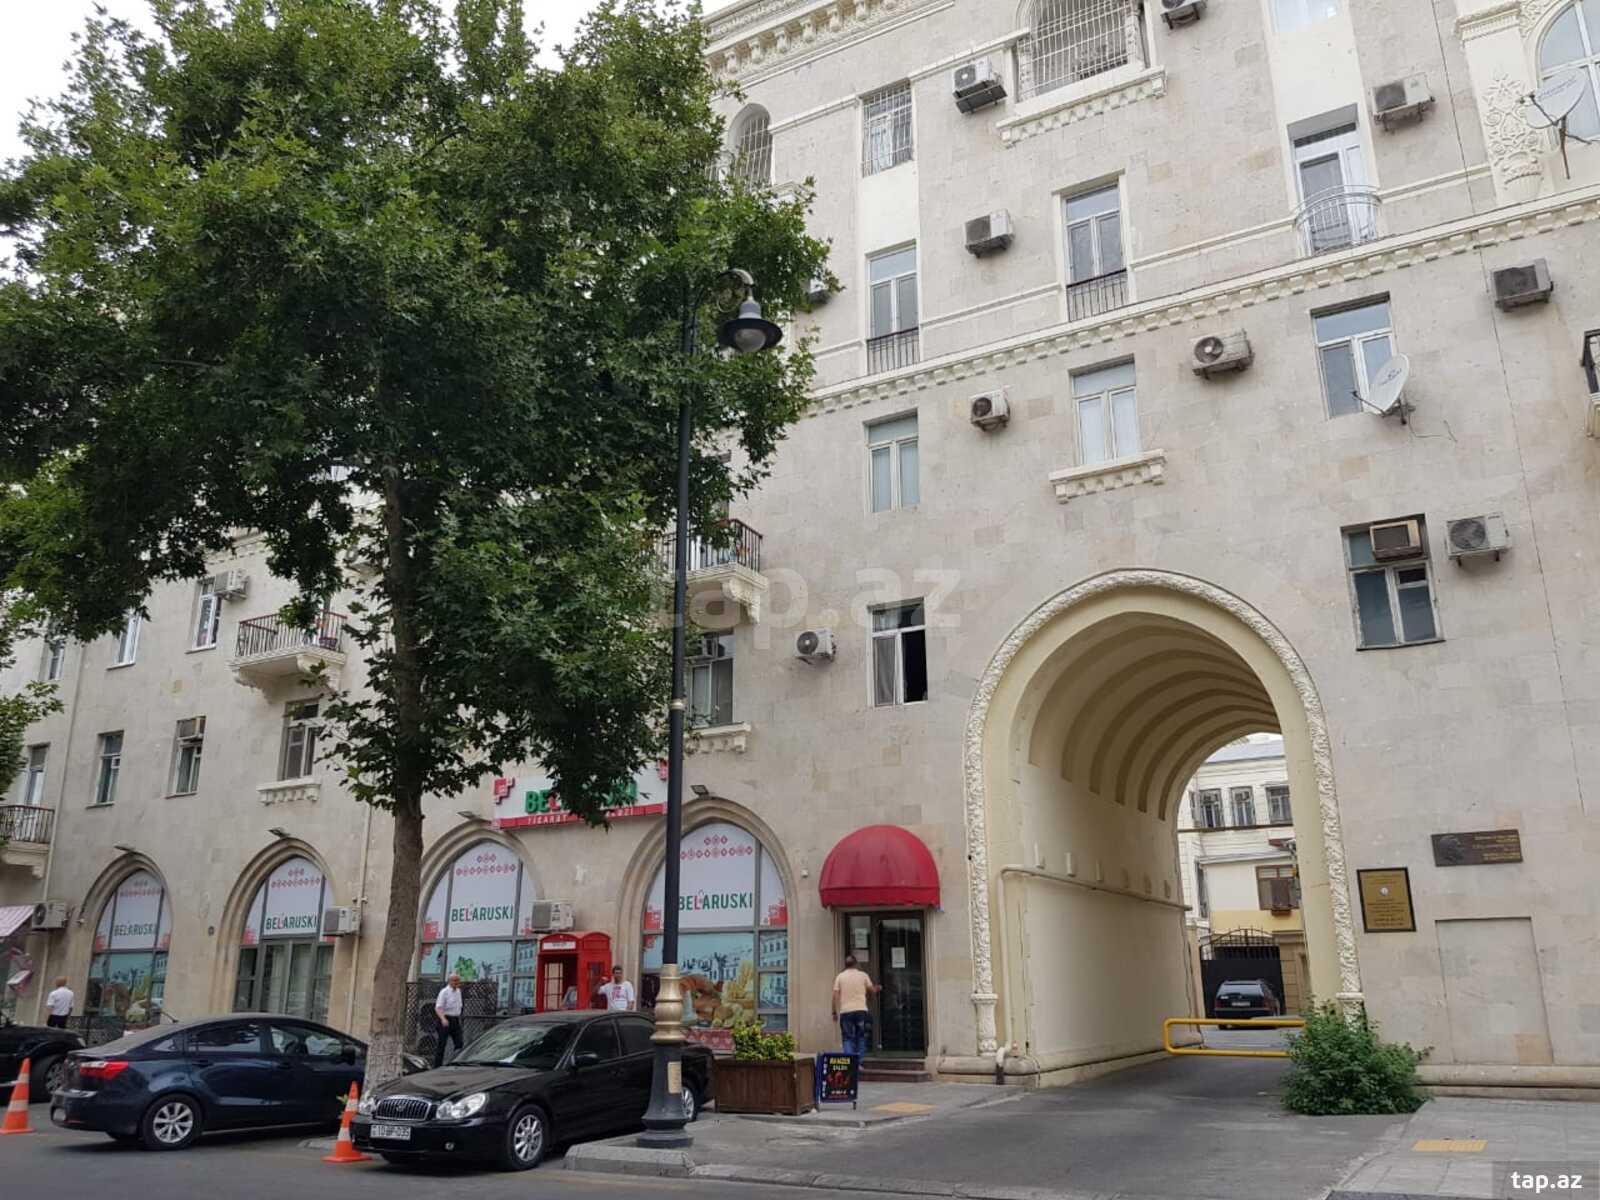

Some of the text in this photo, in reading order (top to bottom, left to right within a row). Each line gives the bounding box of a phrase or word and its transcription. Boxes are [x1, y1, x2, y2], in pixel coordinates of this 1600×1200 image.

[679, 892, 753, 912] BELARUSKI
[265, 914, 319, 930] BELARUSKI
[451, 904, 513, 922] BELARUSKI
